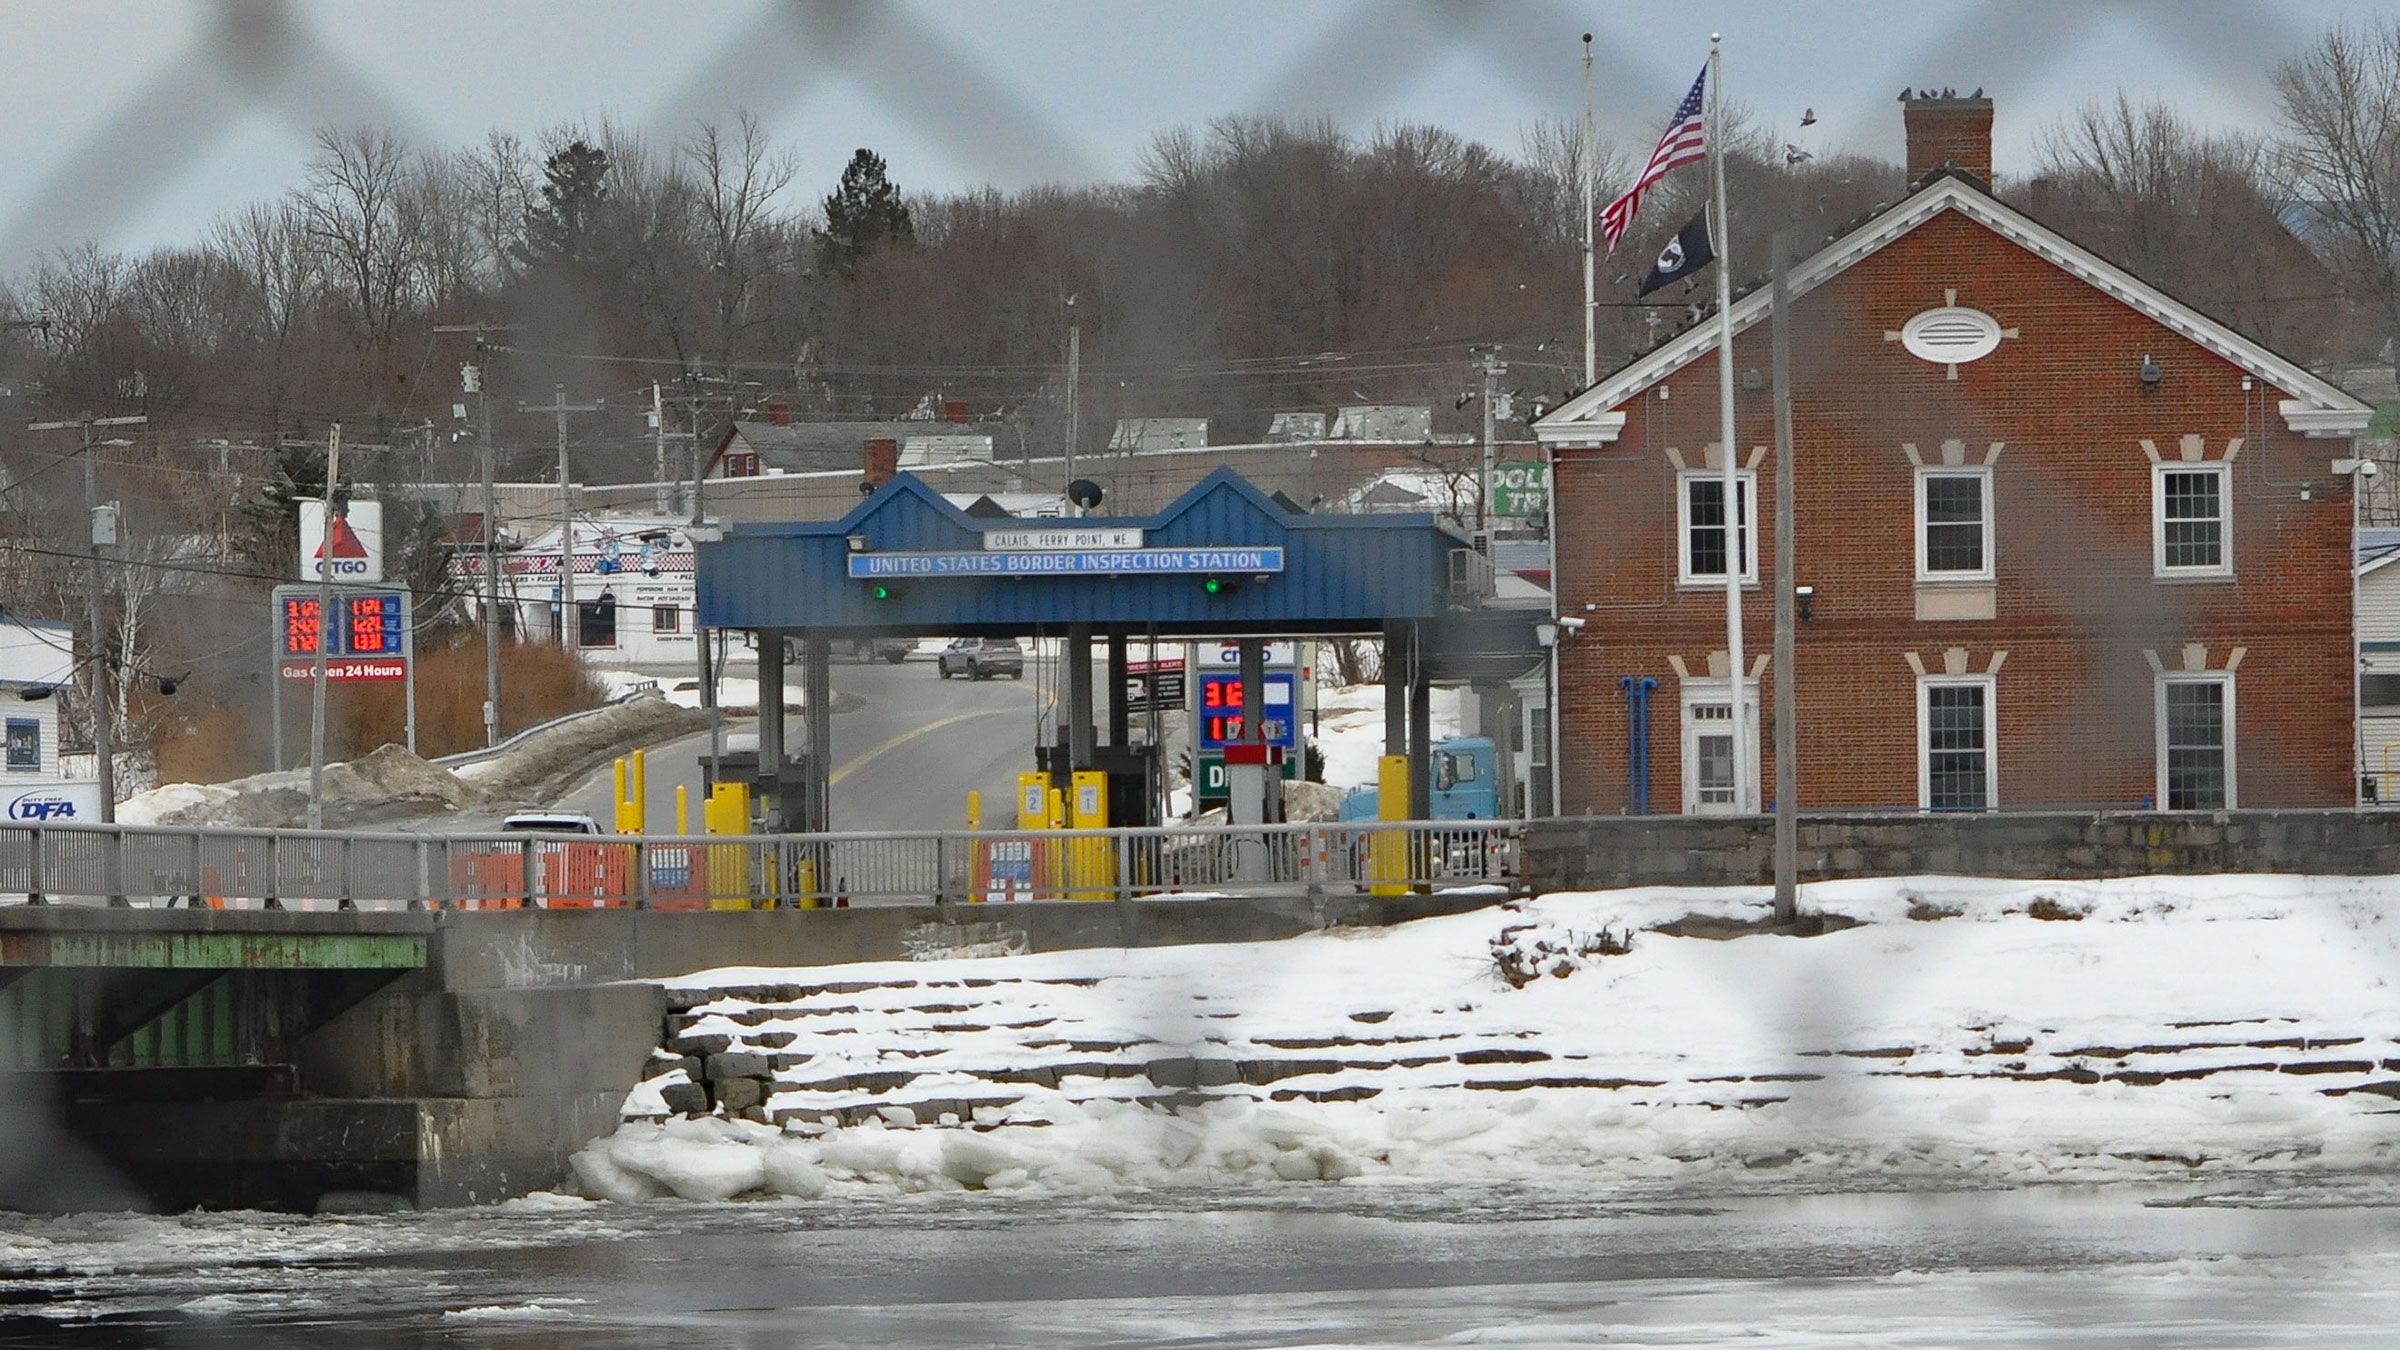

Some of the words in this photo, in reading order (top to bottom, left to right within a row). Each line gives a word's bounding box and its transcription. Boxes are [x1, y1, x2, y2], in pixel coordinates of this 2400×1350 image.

[1039, 534, 1068, 546] FERRY
[315, 561, 367, 574] CTGO
[869, 557, 932, 573] UNITED
[936, 556, 1001, 572] STATES
[1007, 555, 1076, 571] BORDER
[1081, 553, 1183, 570] INSPECTION
[1188, 552, 1262, 568] STATION
[283, 667, 308, 678] Gas
[310, 666, 344, 678] Oen
[345, 665, 362, 677] 24
[364, 664, 403, 676] Hours
[21, 802, 76, 821] DFA
